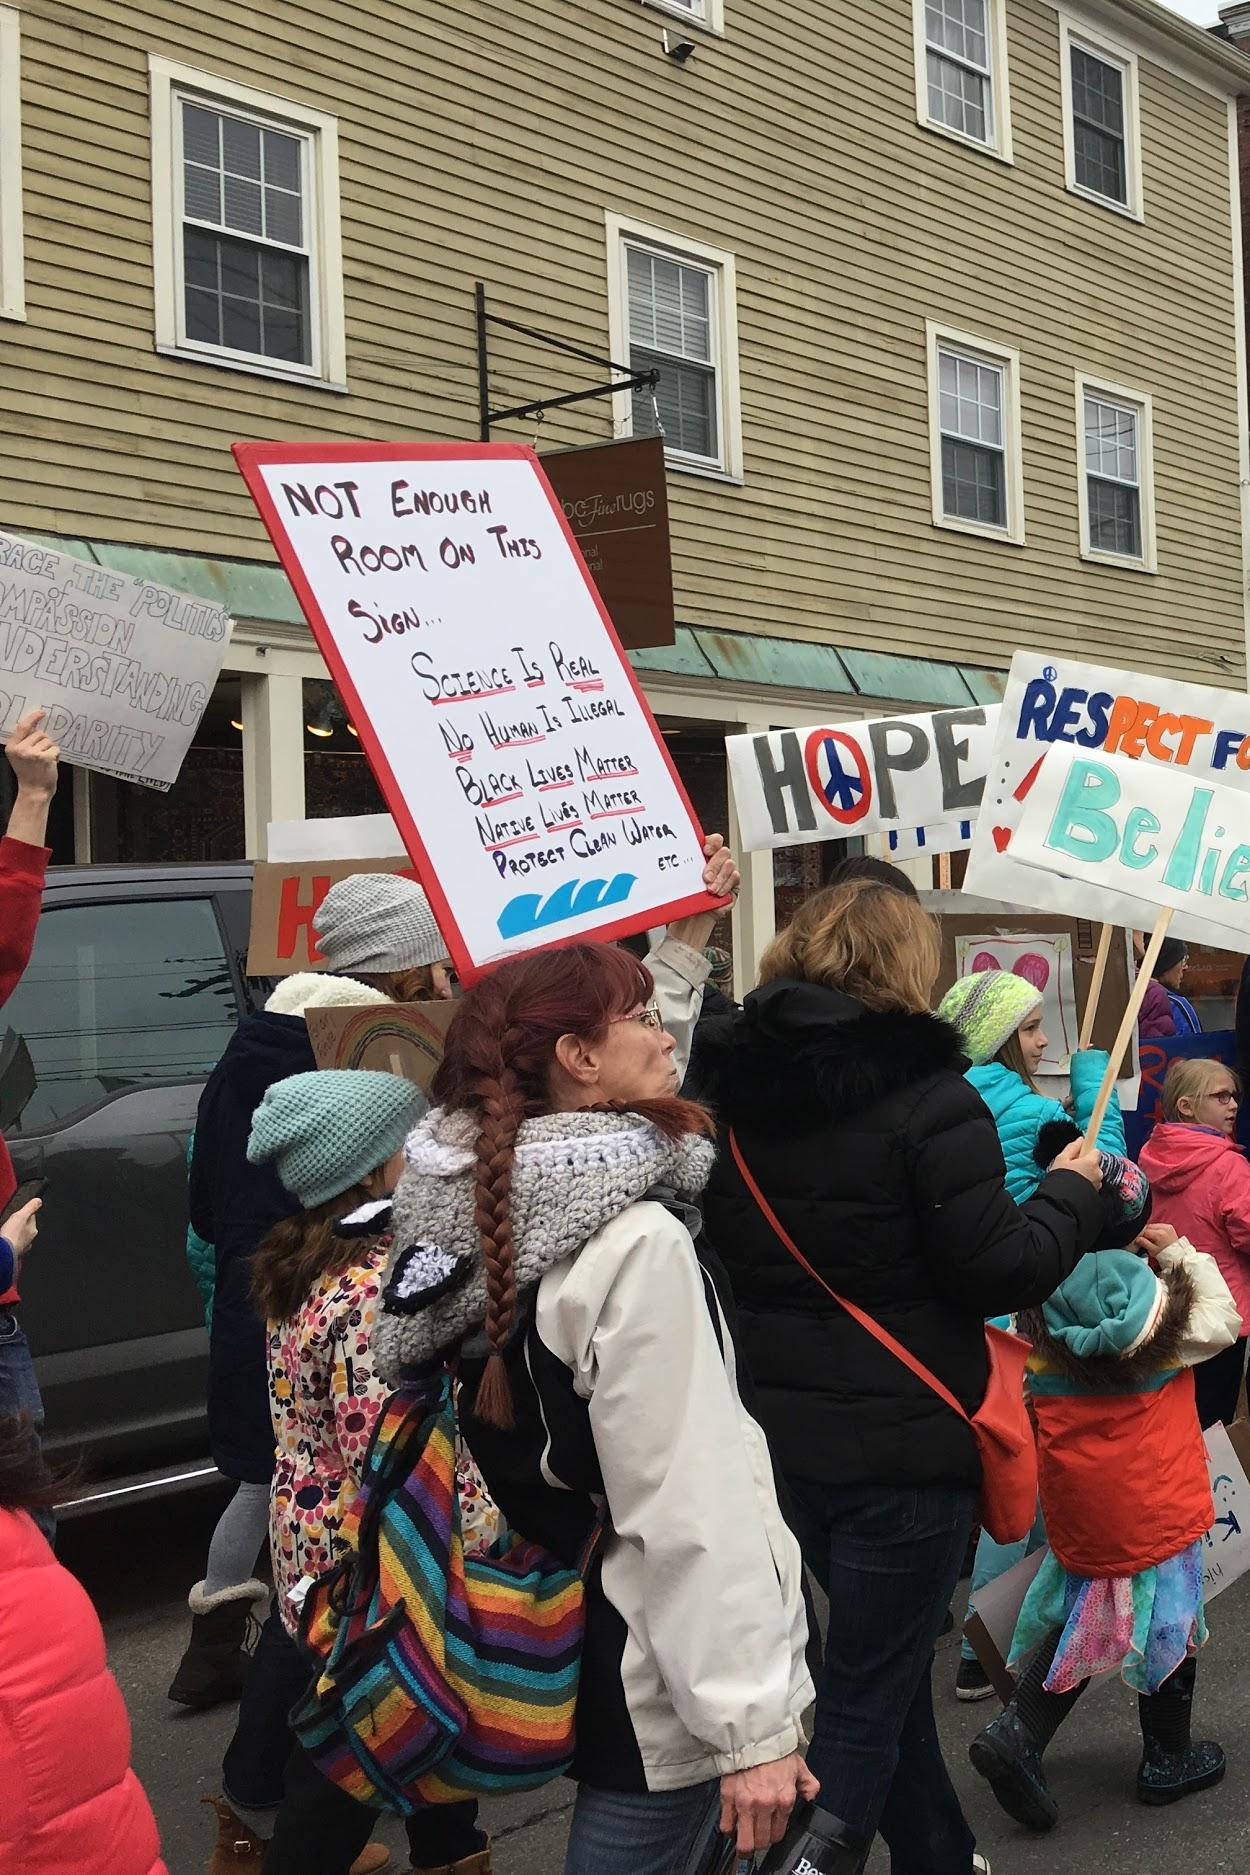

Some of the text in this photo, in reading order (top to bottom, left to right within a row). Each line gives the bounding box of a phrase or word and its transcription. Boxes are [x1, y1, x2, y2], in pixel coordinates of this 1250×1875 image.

[281, 480, 492, 519] NOT ENOUGH
[331, 535, 430, 576] ROOM
[440, 537, 475, 568] ON
[486, 525, 542, 559] THIS
[48, 579, 73, 607] of
[72, 564, 125, 602] THE
[0, 581, 135, 654] MPASSION
[411, 641, 599, 700] SCIENCE IS REAL
[438, 696, 625, 752] NO HUMAN IS ILLEGAL
[1016, 678, 1214, 766] RESPECT
[455, 745, 638, 805] BLACK LIVES MATTER
[753, 709, 987, 833] HOPE
[475, 813, 535, 847] NATIVE
[582, 789, 642, 814] MATTER
[492, 816, 678, 879] PROTECT CLEAN WATER
